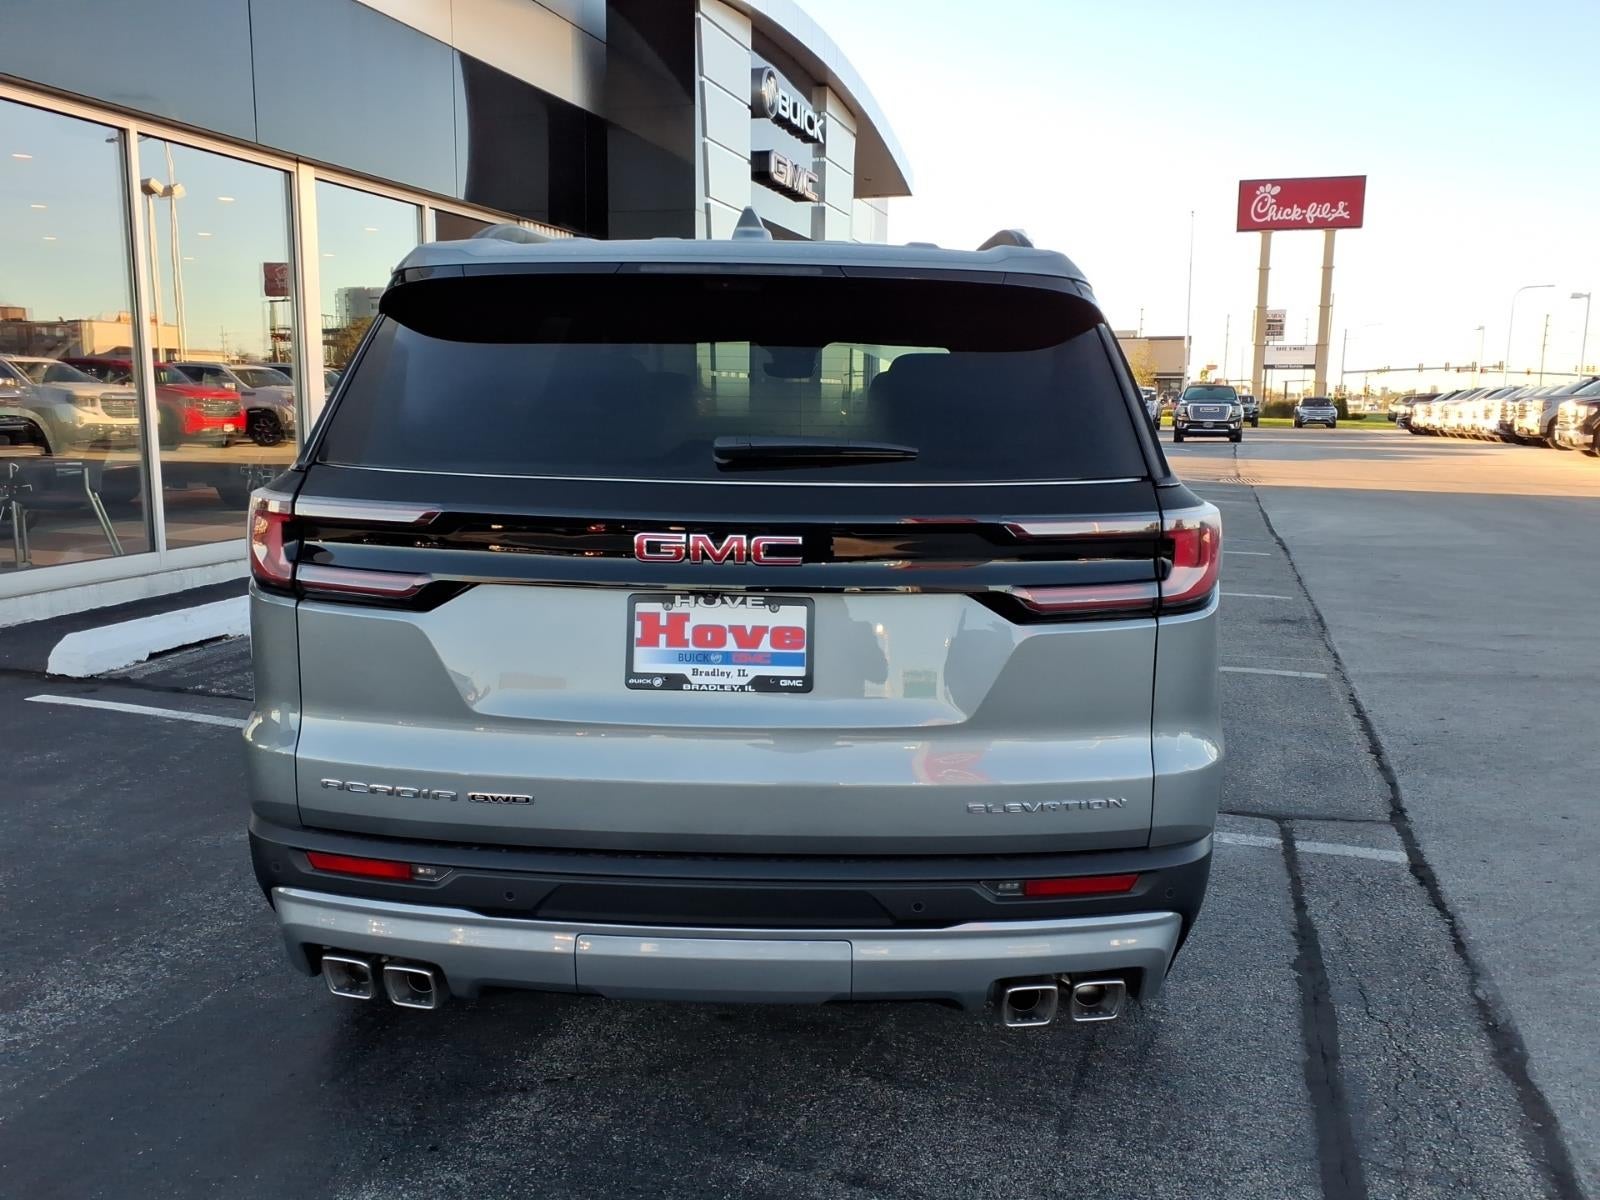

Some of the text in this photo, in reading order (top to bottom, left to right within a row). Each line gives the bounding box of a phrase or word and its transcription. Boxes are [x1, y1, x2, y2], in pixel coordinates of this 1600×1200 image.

[778, 88, 825, 144] BUICK
[769, 150, 819, 200] GMC
[1251, 193, 1350, 223] Chick-fil-A
[633, 532, 803, 566] GMC
[674, 595, 767, 609] HOVE
[635, 611, 806, 651] Hove
[678, 652, 709, 663] BUICK
[691, 668, 749, 679] Bradley, IL
[779, 679, 804, 687] GMC
[682, 684, 742, 692] BRADLEY,
[320, 778, 535, 805] ACADIA AWD
[966, 796, 1128, 814] ELEVATION
